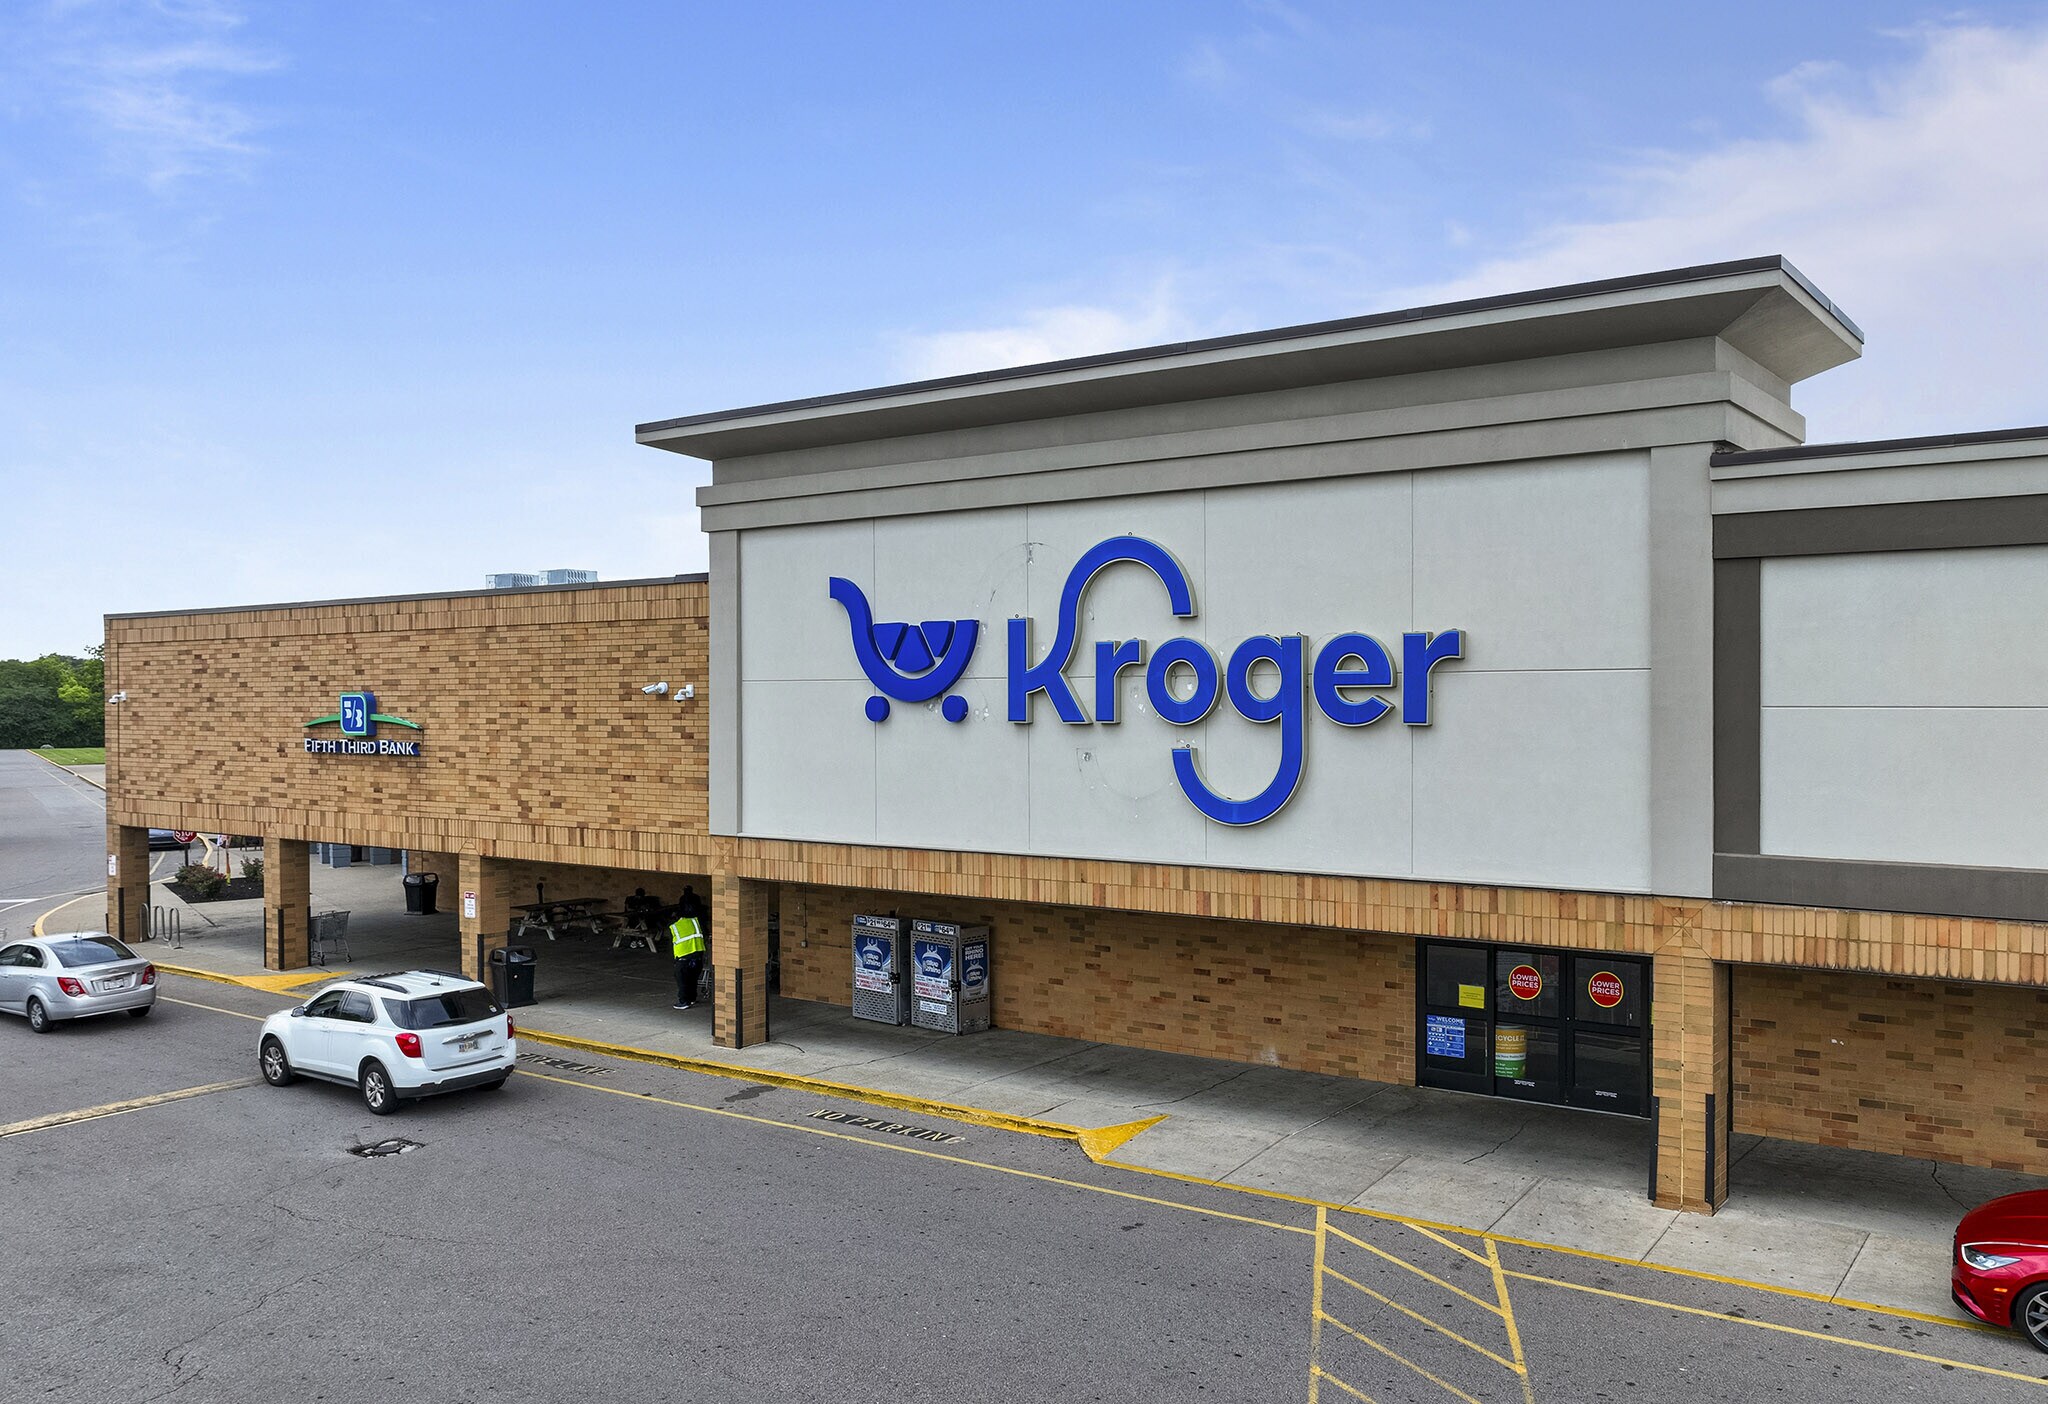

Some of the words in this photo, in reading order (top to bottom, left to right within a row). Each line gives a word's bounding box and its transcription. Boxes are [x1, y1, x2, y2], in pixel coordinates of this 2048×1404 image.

[1007, 535, 1466, 827] Kroger
[304, 738, 336, 753] FIFTH
[339, 739, 376, 754] THIRD
[379, 740, 415, 755] BANK
[1512, 973, 1539, 982] LOWER
[1511, 979, 1539, 989] PRICES
[1592, 980, 1620, 989] LOWER
[1591, 987, 1620, 996] PRICES
[1436, 1016, 1464, 1024] WELCOME
[806, 1109, 846, 1121] NO
[844, 1116, 966, 1144] PARKING
